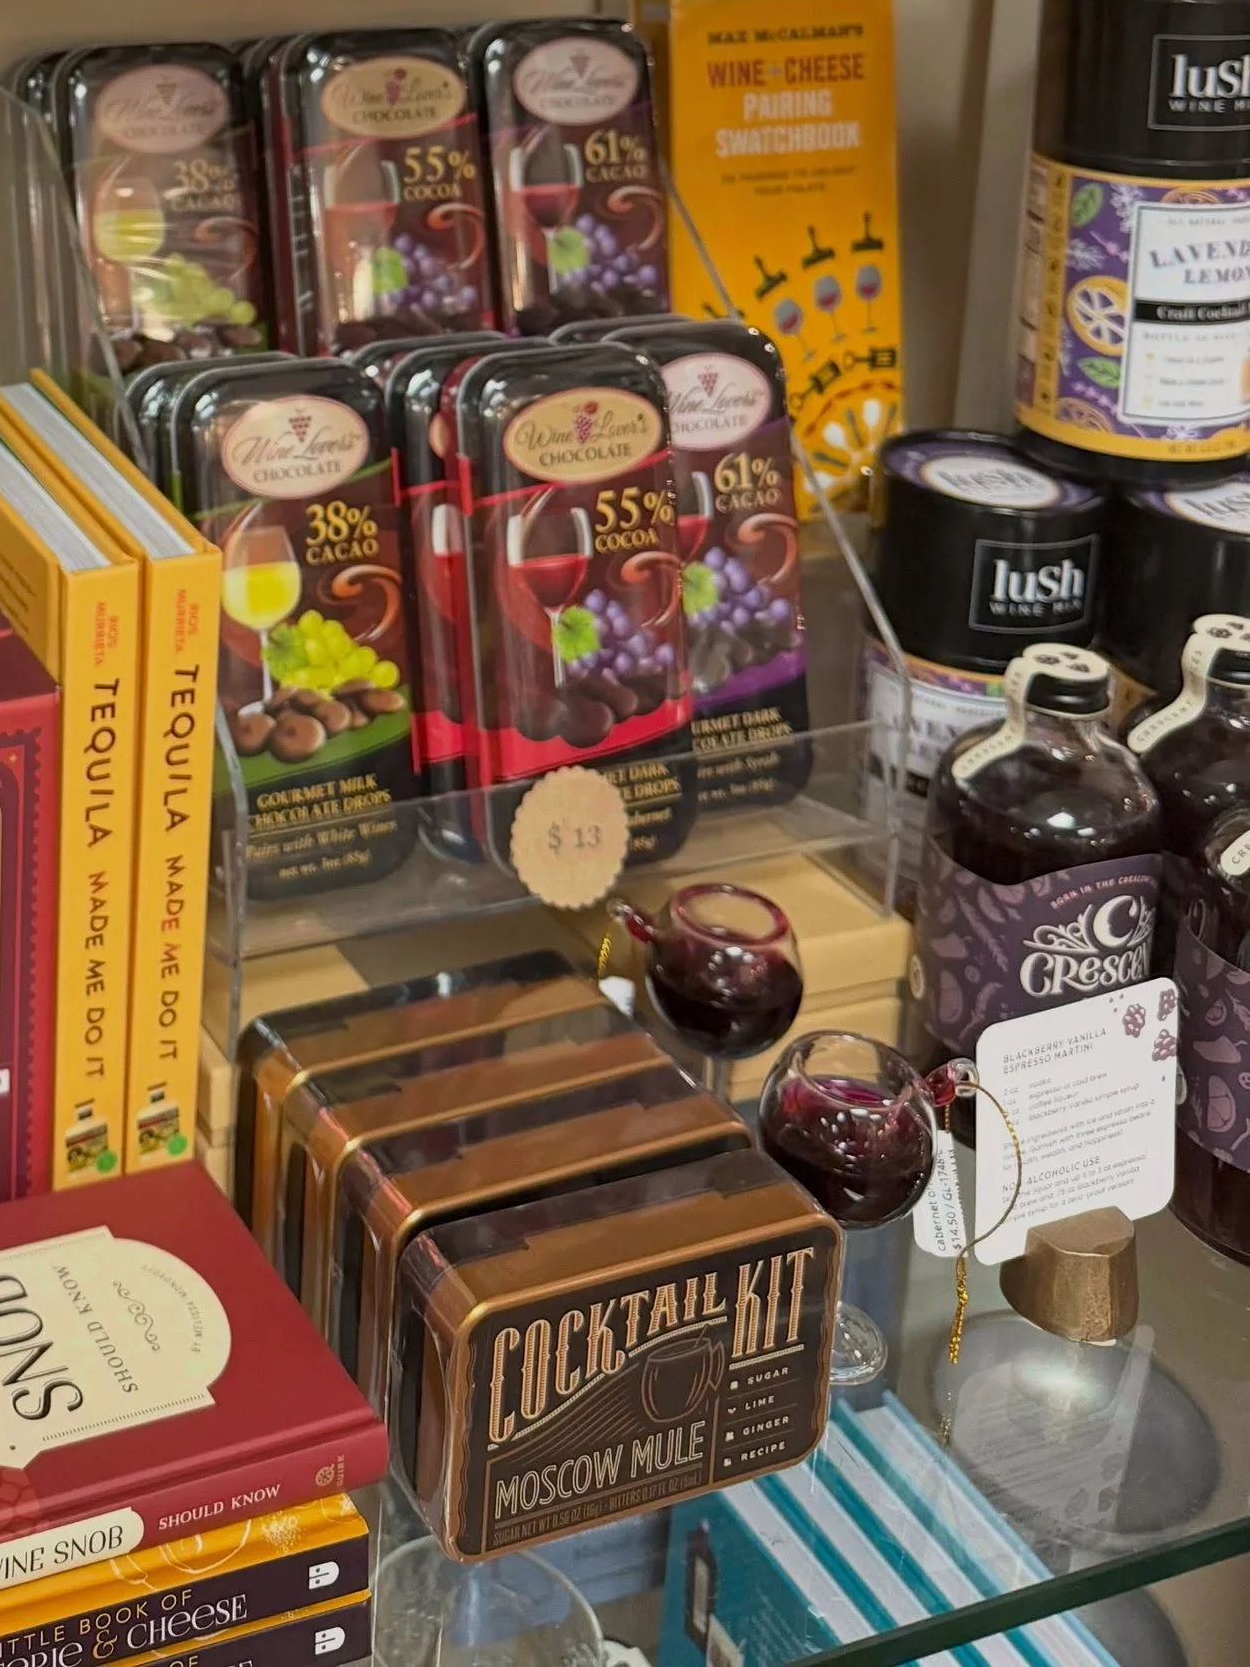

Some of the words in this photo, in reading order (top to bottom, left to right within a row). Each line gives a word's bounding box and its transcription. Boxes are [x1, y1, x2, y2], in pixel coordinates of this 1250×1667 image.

[707, 29, 748, 45] MAX
[707, 59, 765, 88] WINE
[783, 54, 866, 85] CHEESE
[742, 89, 833, 120] PAIRING
[715, 121, 861, 159] SWATCHBOOK
[538, 442, 633, 468] CHOCOLATE
[713, 451, 782, 494] 61%
[594, 486, 676, 534] 55%
[715, 487, 781, 515] CACAO
[306, 500, 378, 546] 38%
[594, 528, 660, 553] COCOA
[306, 537, 380, 565] CACAO
[84, 677, 120, 848] TEQUILA
[85, 870, 110, 950] MADE
[84, 959, 106, 997] ME
[84, 1006, 105, 1046] DO
[1003, 1039, 1064, 1064] BLACKBERRY
[1067, 1027, 1108, 1046] VANILLA
[1003, 1053, 1052, 1075] ESPRESSO
[1053, 1043, 1094, 1061] MARTINI
[86, 1057, 105, 1079] IT
[945, 1211, 962, 1251] $14.50
[52, 1263, 93, 1318] KNOW
[85, 1317, 140, 1394] SHOULD
[487, 1271, 727, 1445] COCKTAIL
[731, 1245, 814, 1359] KIT
[746, 1366, 789, 1386] SUGAR
[744, 1394, 775, 1411] LIME
[742, 1415, 790, 1437] GINGER
[494, 1444, 624, 1520] MOSCOW
[630, 1420, 706, 1479] MULE
[740, 1441, 786, 1462] RECIPE
[51, 1525, 125, 1568] SNOB
[157, 1499, 226, 1532] SHOULD
[230, 1483, 283, 1515] KNOW
[79, 1604, 154, 1637] BOOK
[159, 1588, 195, 1618] OF
